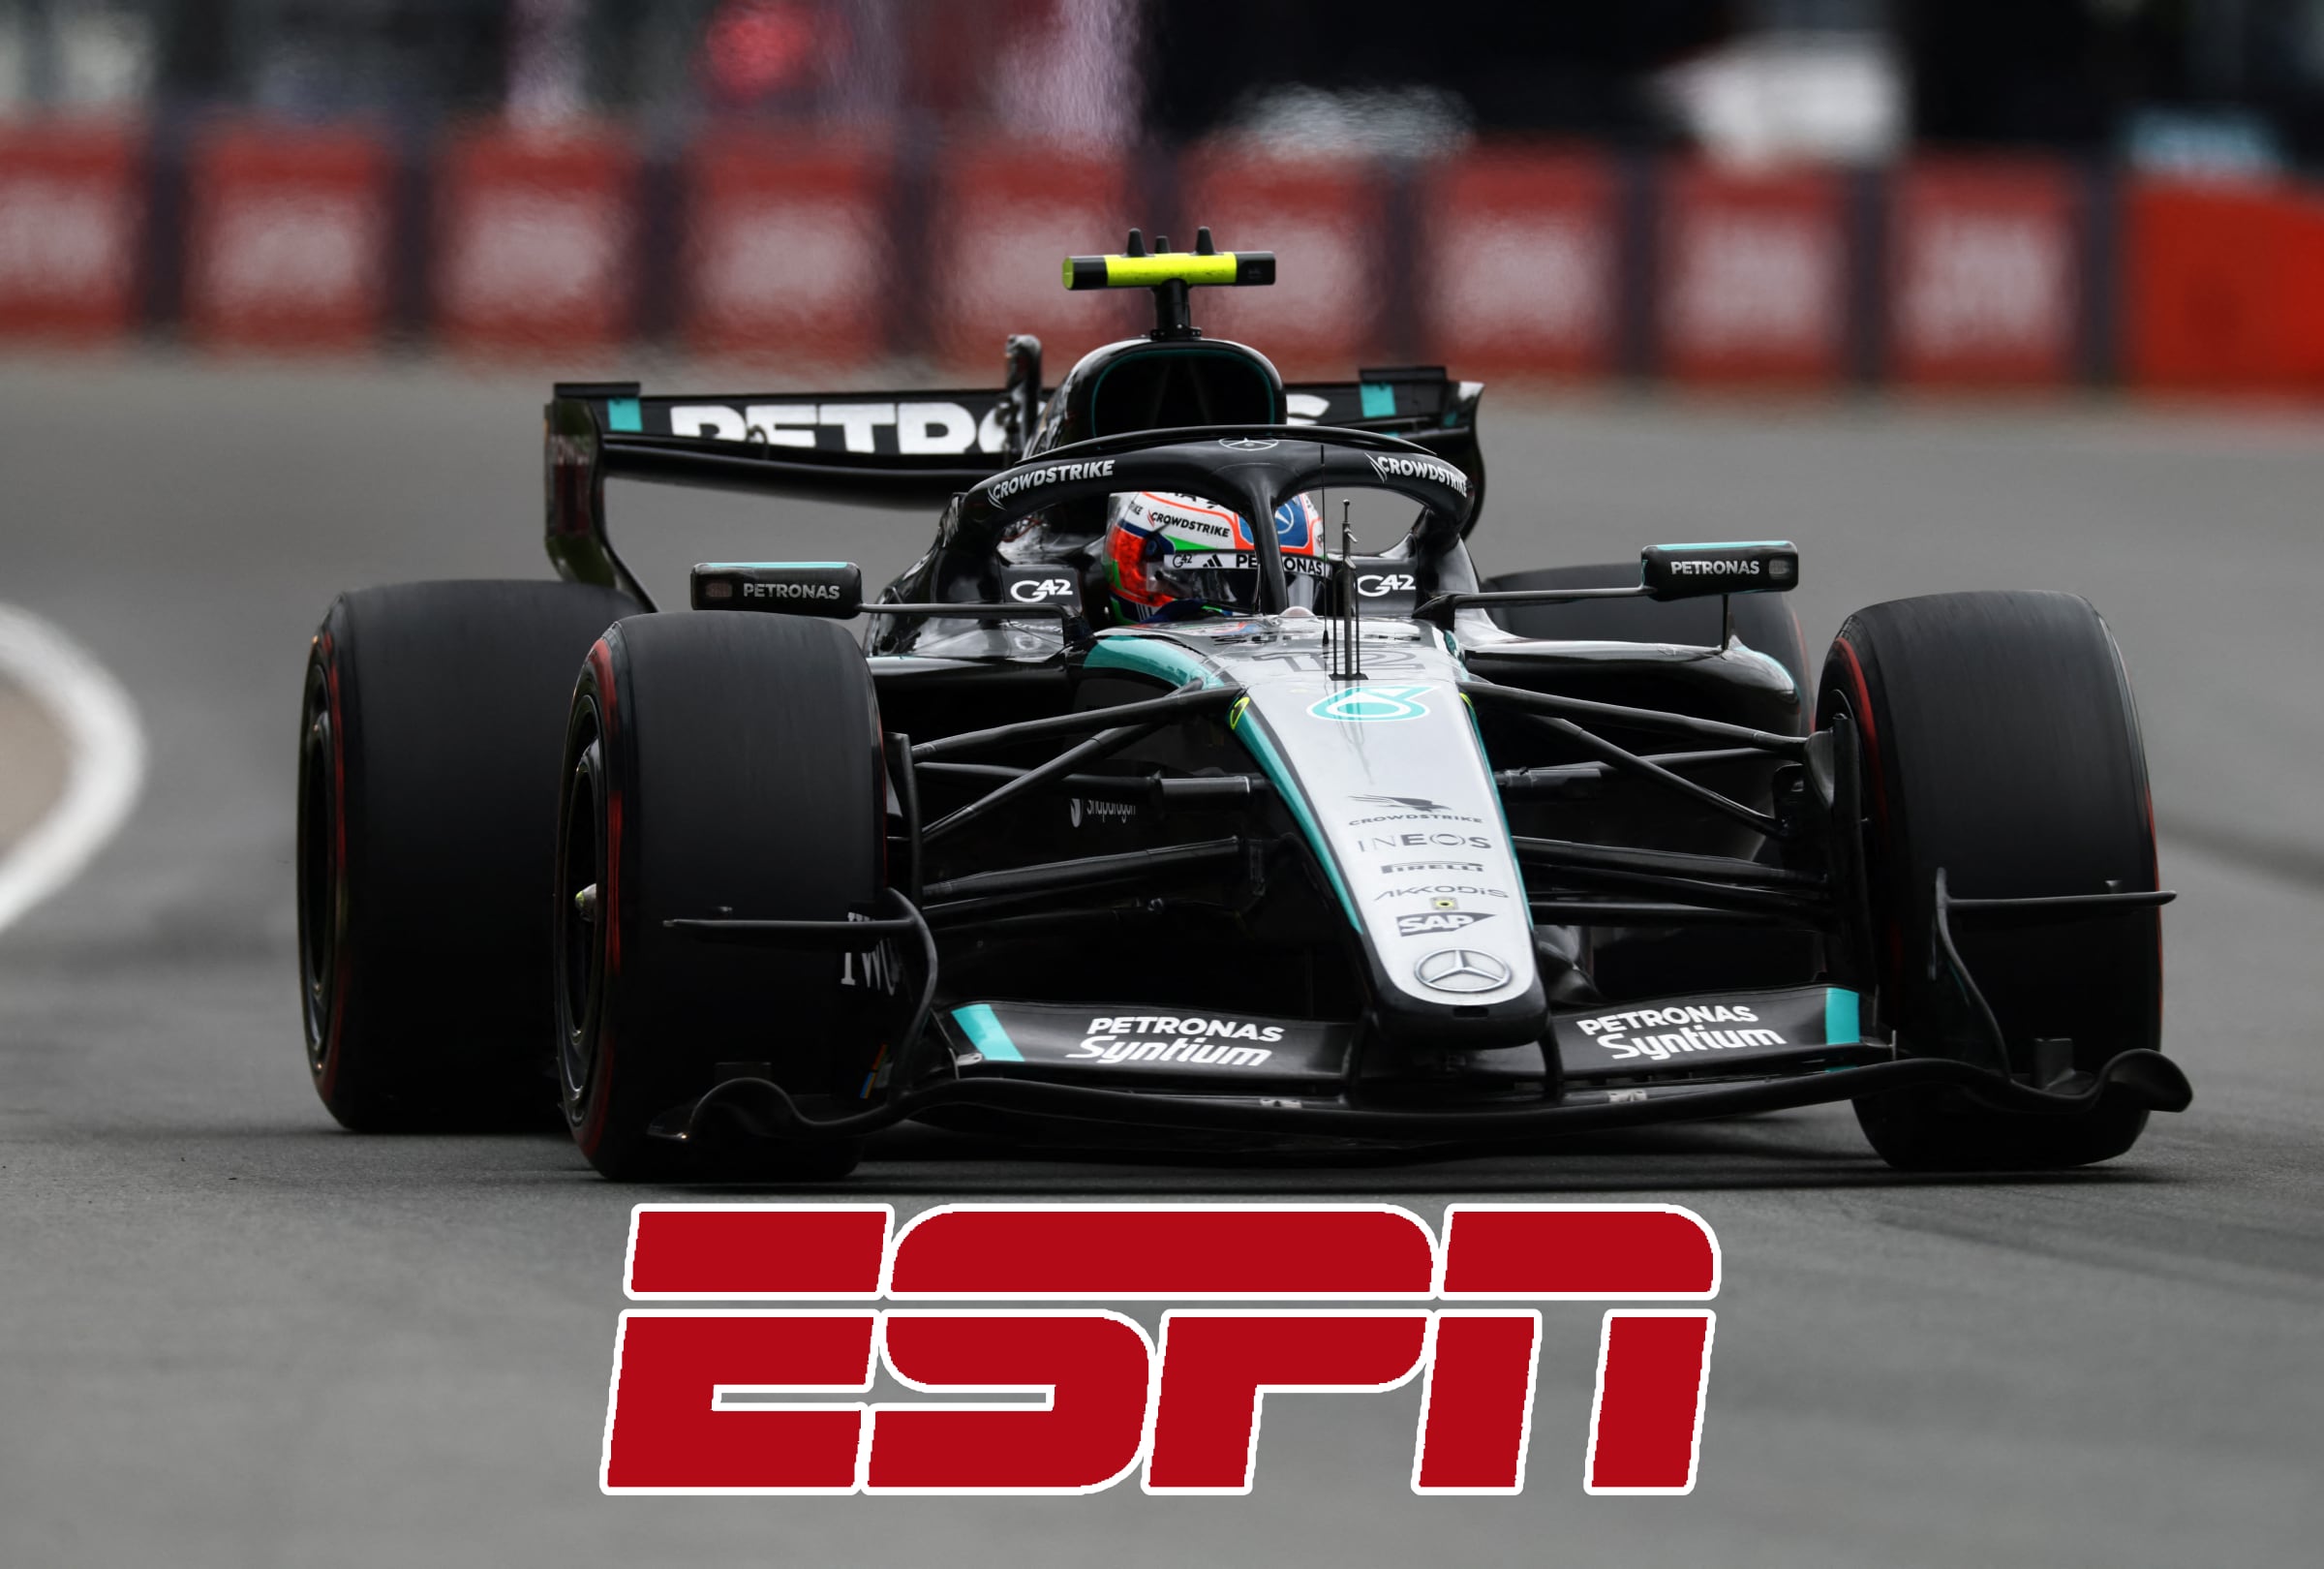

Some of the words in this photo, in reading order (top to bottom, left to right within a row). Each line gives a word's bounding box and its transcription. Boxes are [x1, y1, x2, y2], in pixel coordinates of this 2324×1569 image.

[993, 460, 1116, 500] CROWDSTRIKE
[1377, 456, 1468, 498] CROWDSTRIKE
[1151, 511, 1231, 538] CROWDSTRIKE
[1172, 553, 1193, 569] G42
[1235, 552, 1323, 575] PEONAS
[1670, 560, 1760, 575] PETRONAS
[743, 582, 841, 600] PETRONAS
[1010, 578, 1074, 603] G42
[1357, 573, 1417, 598] G42
[1348, 814, 1483, 827] CROWDSTRIKE
[1358, 833, 1492, 853] INEOS
[1380, 860, 1484, 875] PIRELLI
[1397, 913, 1475, 935] SAP
[1086, 1016, 1286, 1043] PETRONAS
[1576, 1005, 1759, 1036] PETRONAS
[1066, 1034, 1273, 1066] Syntium
[1596, 1024, 1788, 1061] Syntium
